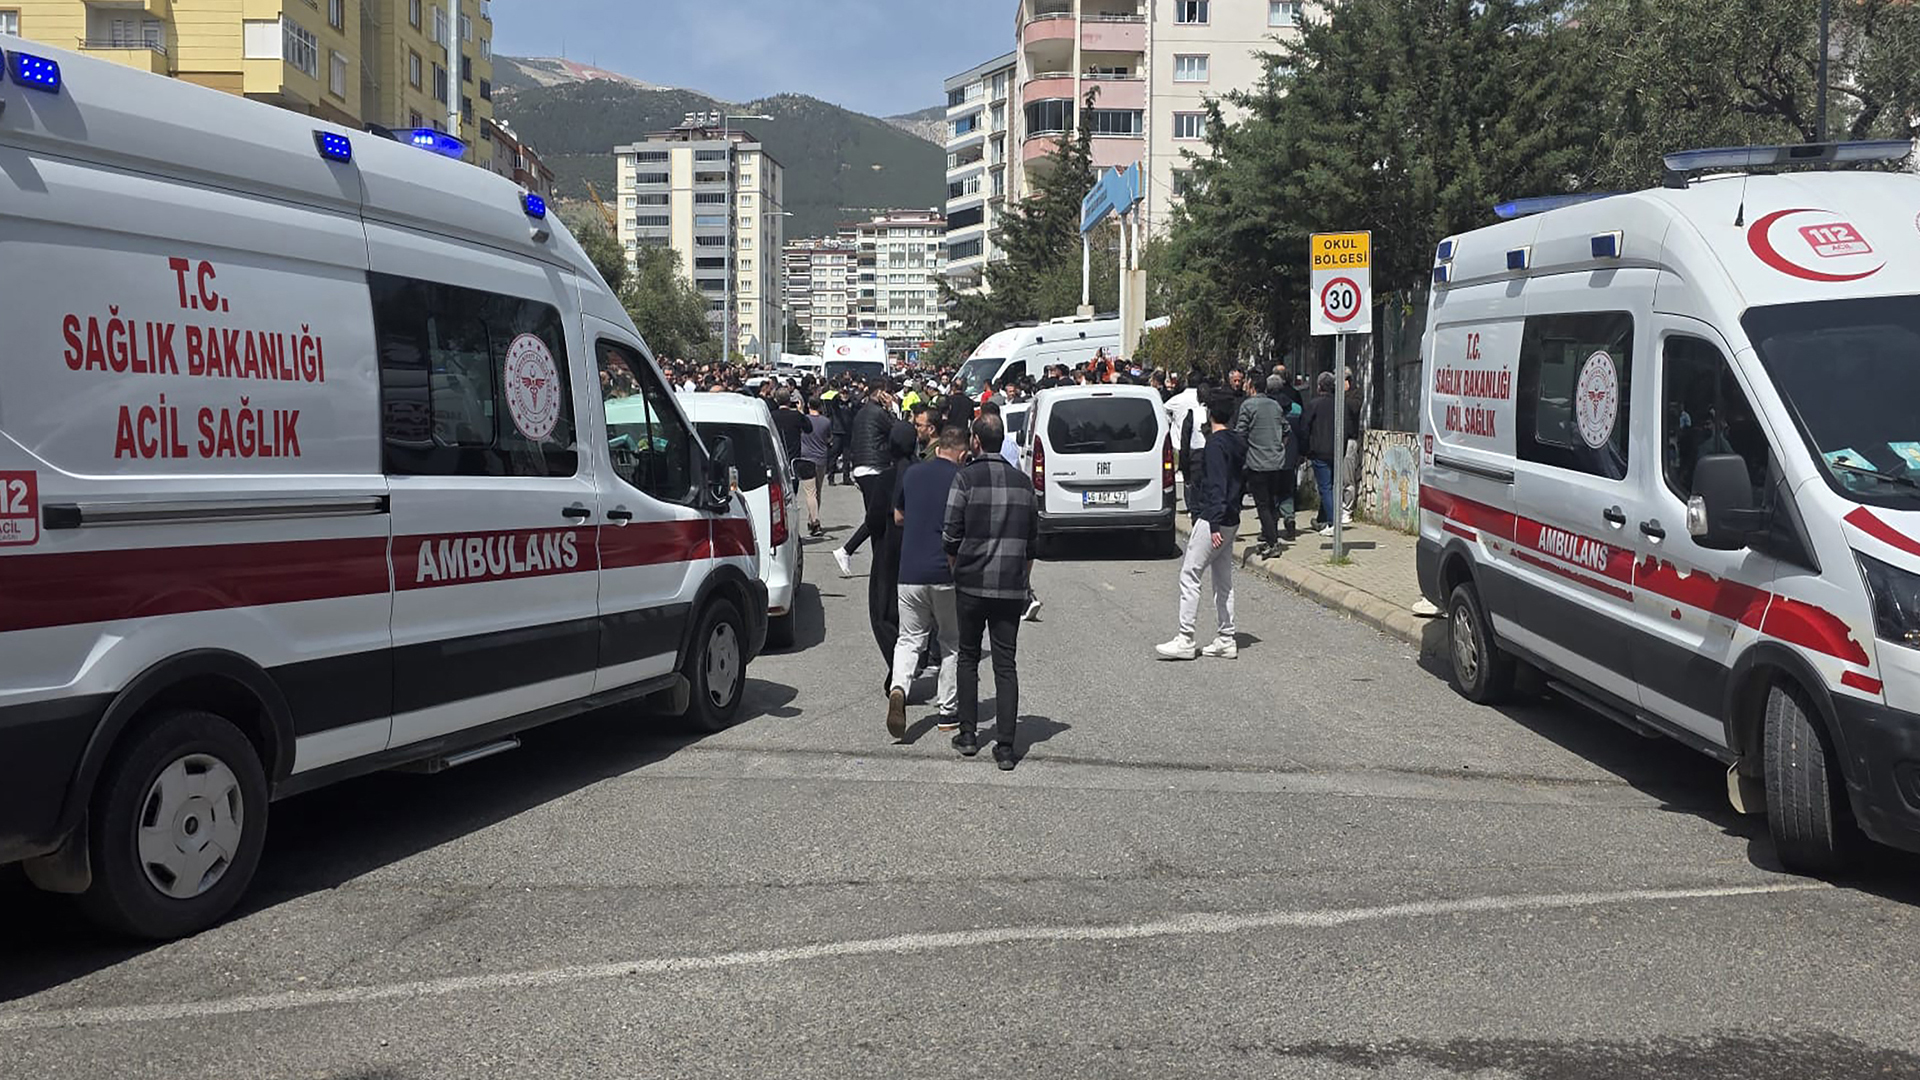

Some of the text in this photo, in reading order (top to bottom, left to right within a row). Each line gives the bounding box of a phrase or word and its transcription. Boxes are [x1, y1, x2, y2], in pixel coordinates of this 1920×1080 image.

[1324, 240, 1357, 250] OKUL
[1808, 227, 1856, 243] 112
[1314, 250, 1367, 265] BÖLGESİ
[168, 256, 229, 312] T.C.
[1329, 289, 1352, 310] 30
[62, 305, 325, 382] SAĞLIK BAKANLIĞI
[1466, 333, 1480, 360] T.C.
[1435, 363, 1511, 400] SAĞLIK BAKANLIĞI
[114, 392, 301, 459] ACİL SAĞLIK
[1445, 400, 1496, 437] ACİL SAĞLIK
[1097, 461, 1111, 475] FIAT
[416, 531, 578, 582] AMBULANS
[1538, 526, 1608, 571] AMBULANS
